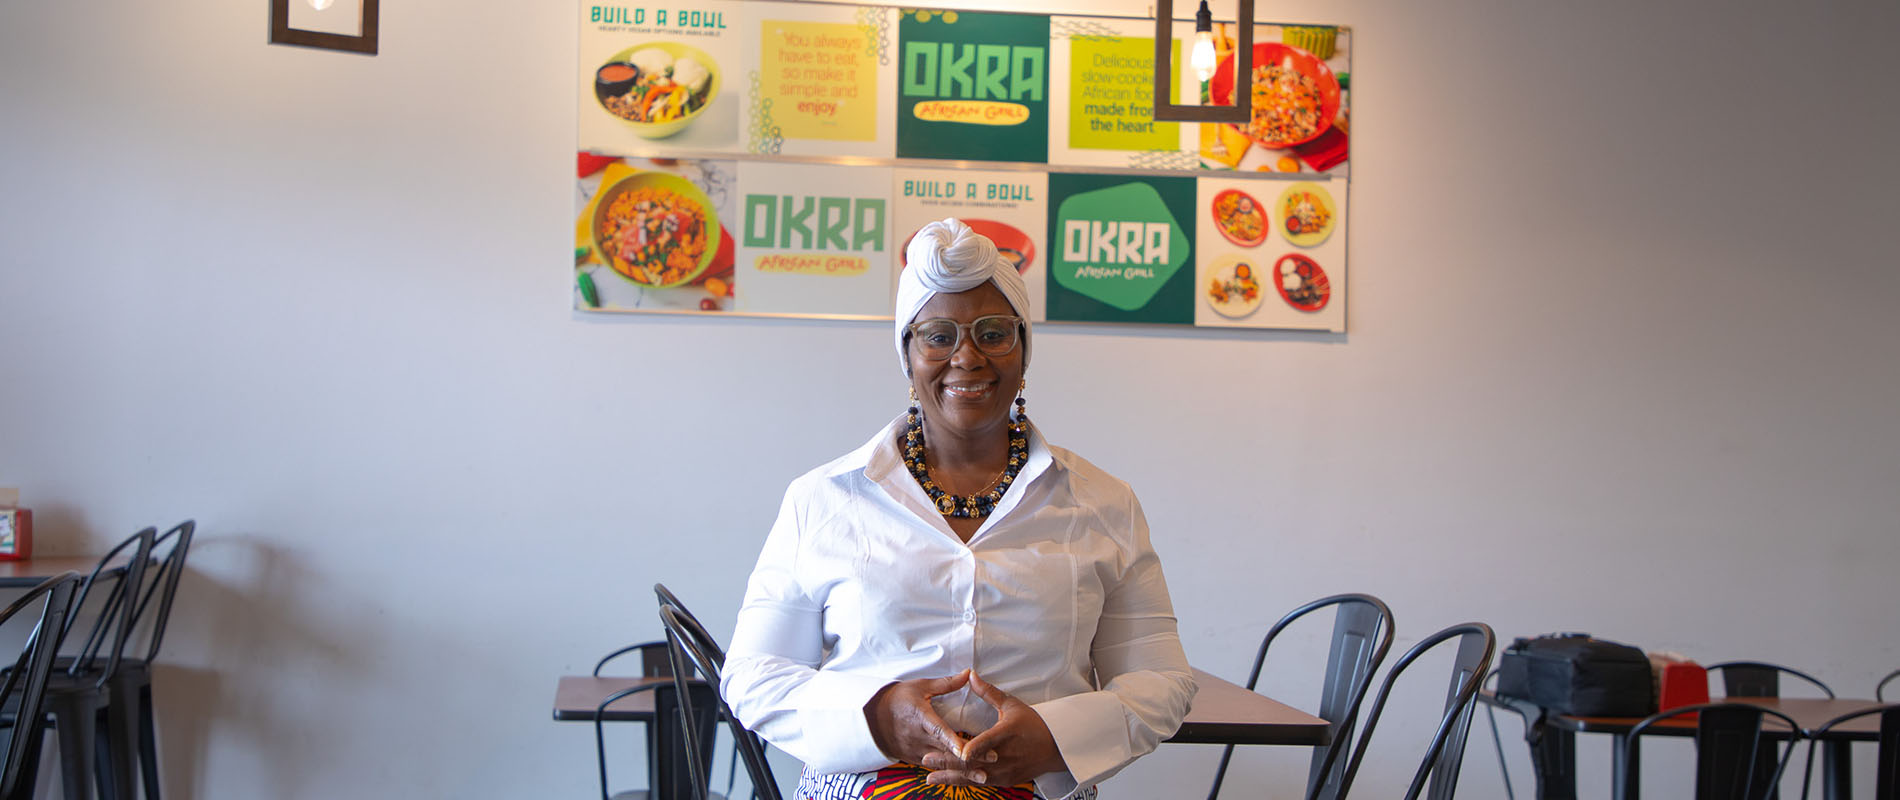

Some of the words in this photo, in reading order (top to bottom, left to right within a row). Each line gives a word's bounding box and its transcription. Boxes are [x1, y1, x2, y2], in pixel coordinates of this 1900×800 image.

[591, 6, 645, 24] BUILD
[656, 9, 667, 26] A
[678, 10, 727, 29] BOWL
[814, 33, 861, 51] always
[778, 48, 812, 63] have
[816, 51, 831, 64] to
[783, 68, 800, 80] so
[804, 67, 842, 81] make
[847, 70, 856, 82] it
[903, 41, 1044, 101] OKRA
[779, 79, 827, 97] simple
[831, 83, 858, 98] and
[1082, 85, 1130, 100] African
[1135, 87, 1153, 101] foo
[920, 104, 980, 118] AFRICAN
[984, 106, 1023, 120] GRILL
[1084, 102, 1126, 116] made
[1090, 118, 1113, 131] the
[904, 180, 956, 198] BUILD
[966, 183, 976, 199] A
[987, 183, 1034, 201] BOWL
[743, 194, 886, 252] OKRA
[1063, 219, 1170, 264] OKRA
[757, 254, 821, 272] AFRICAN
[825, 257, 865, 272] GRILL
[1075, 265, 1122, 280] AFRICAN
[1124, 267, 1154, 280] GRILL
